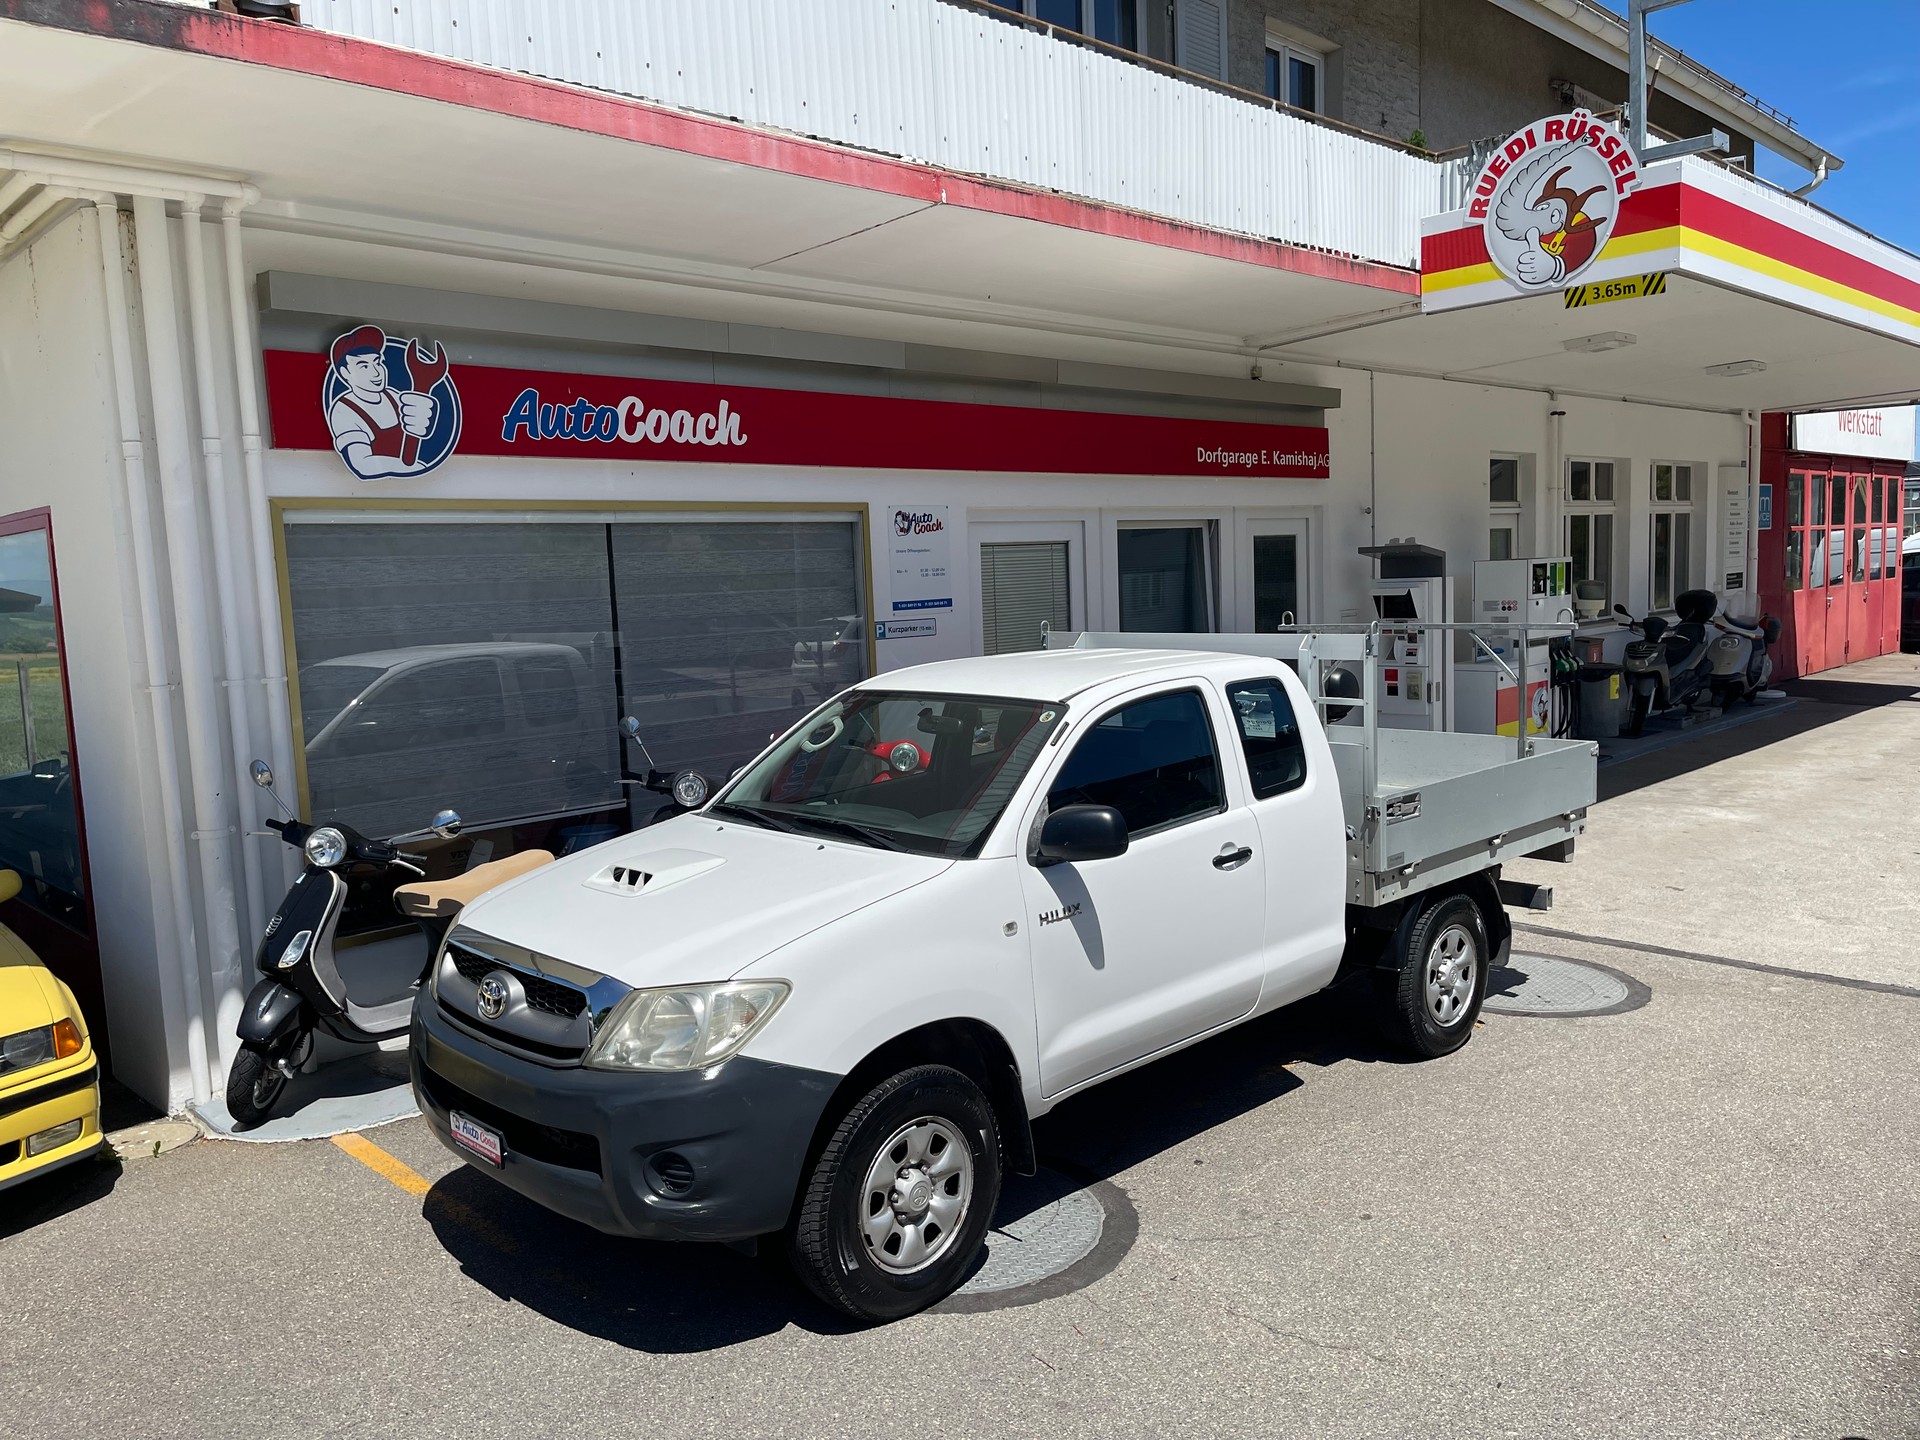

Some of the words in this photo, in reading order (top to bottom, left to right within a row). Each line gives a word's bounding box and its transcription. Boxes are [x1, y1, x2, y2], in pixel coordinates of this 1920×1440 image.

[1469, 128, 1537, 219] RUEDI
[1544, 112, 1637, 195] RÜSSEL
[1592, 282, 1636, 300] 3.65m
[1838, 410, 1882, 437] Werkstatt
[1197, 447, 1258, 468] Dorfgarage
[1261, 450, 1270, 465] E.
[911, 512, 933, 524] Auto
[914, 518, 944, 535] Coach
[888, 625, 918, 634] Kurzparker
[1039, 902, 1082, 922] HILUX
[462, 1120, 480, 1141] Auto
